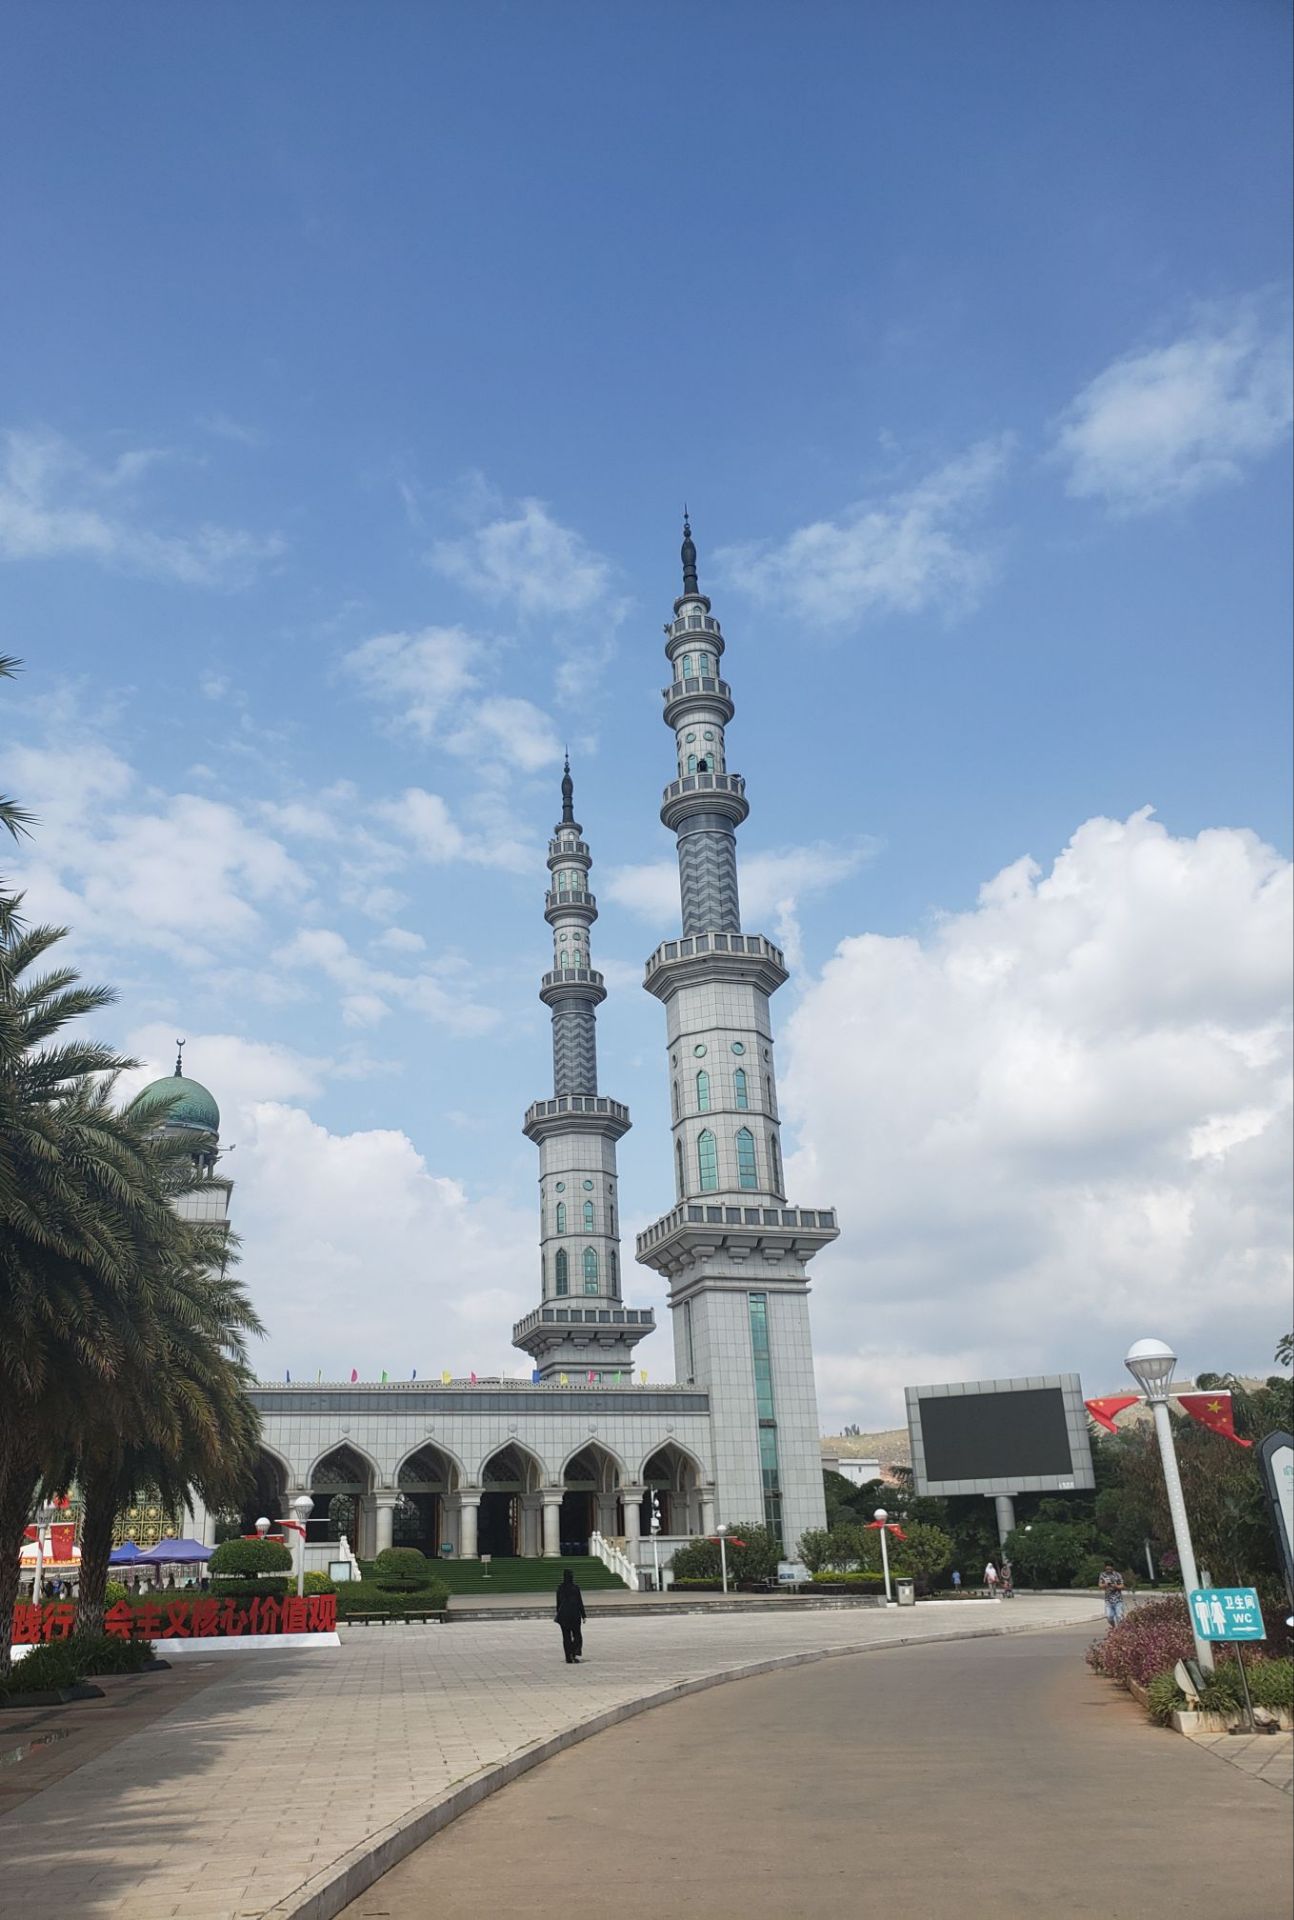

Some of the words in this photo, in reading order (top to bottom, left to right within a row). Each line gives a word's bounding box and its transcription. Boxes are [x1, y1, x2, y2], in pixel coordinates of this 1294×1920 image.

[1224, 1595, 1255, 1609] 卫生间
[11, 1594, 337, 1644] 践行会主义核心价值观
[1233, 1613, 1252, 1623] WC
